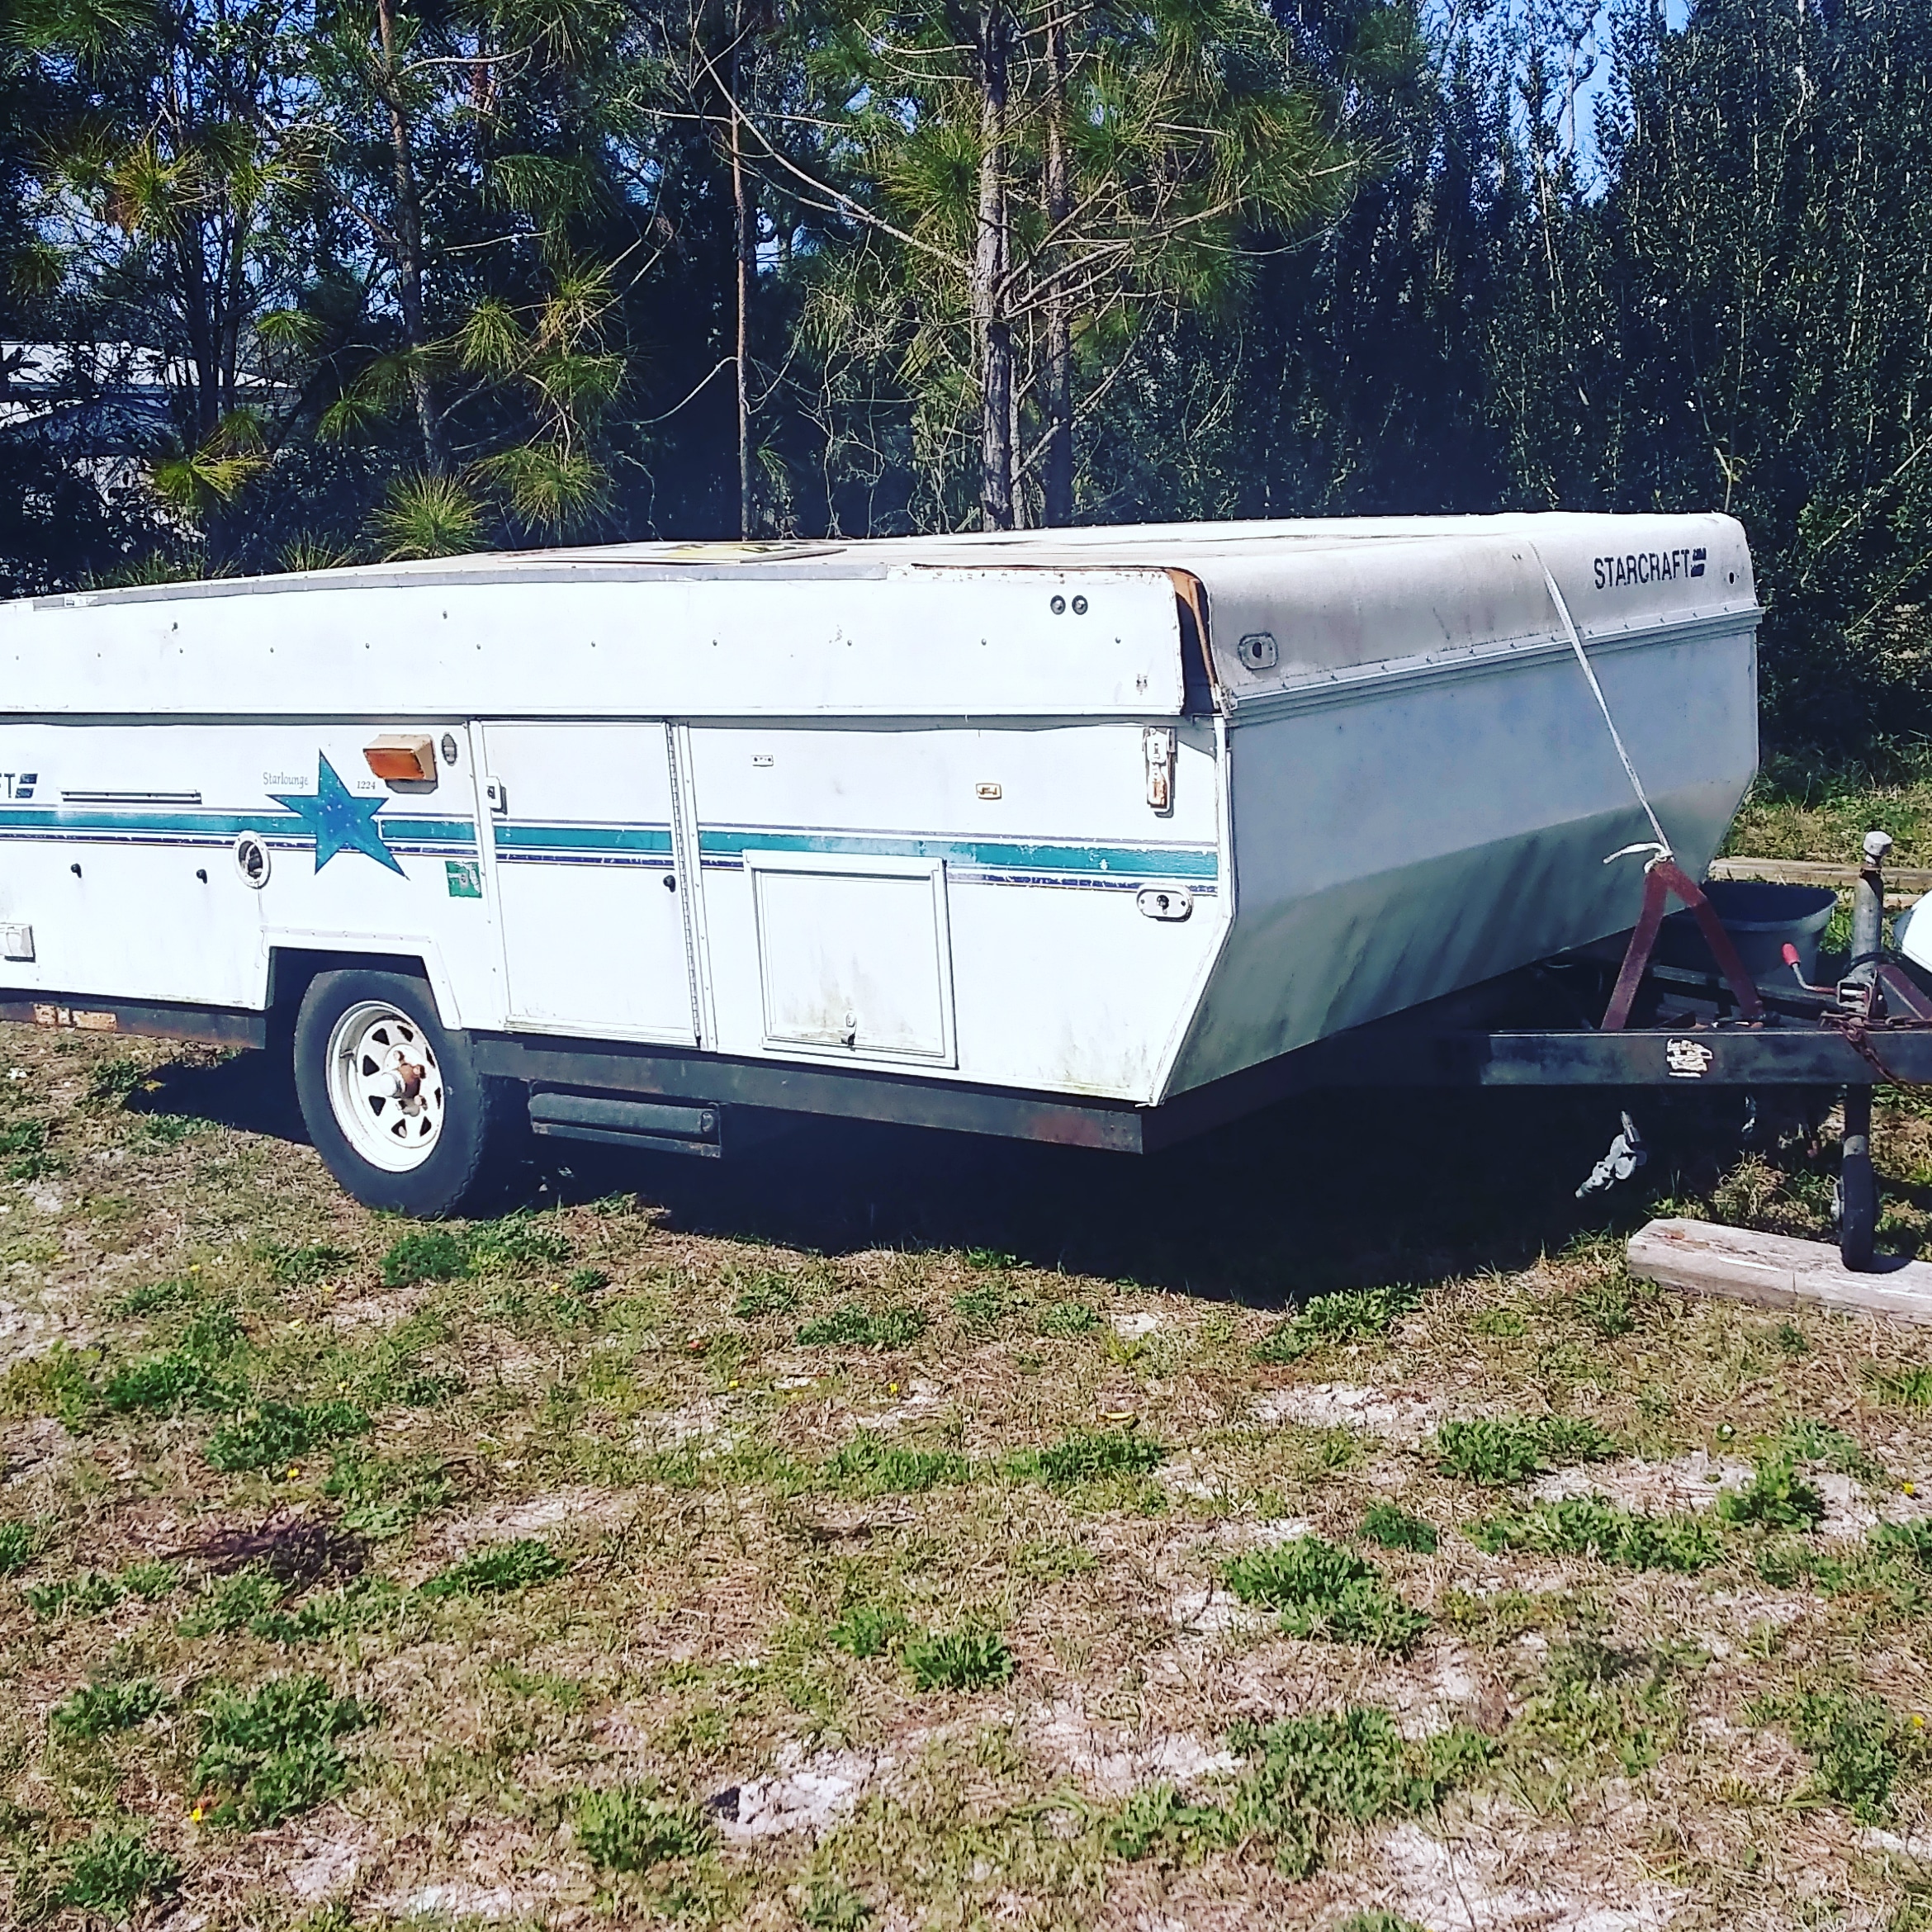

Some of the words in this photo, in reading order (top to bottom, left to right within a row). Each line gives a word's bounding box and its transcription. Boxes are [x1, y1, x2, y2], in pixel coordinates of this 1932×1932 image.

[1593, 548, 1690, 590] STARCRAFT
[0, 772, 16, 798] T
[263, 771, 309, 789] Starlounge
[357, 780, 376, 789] 1224
